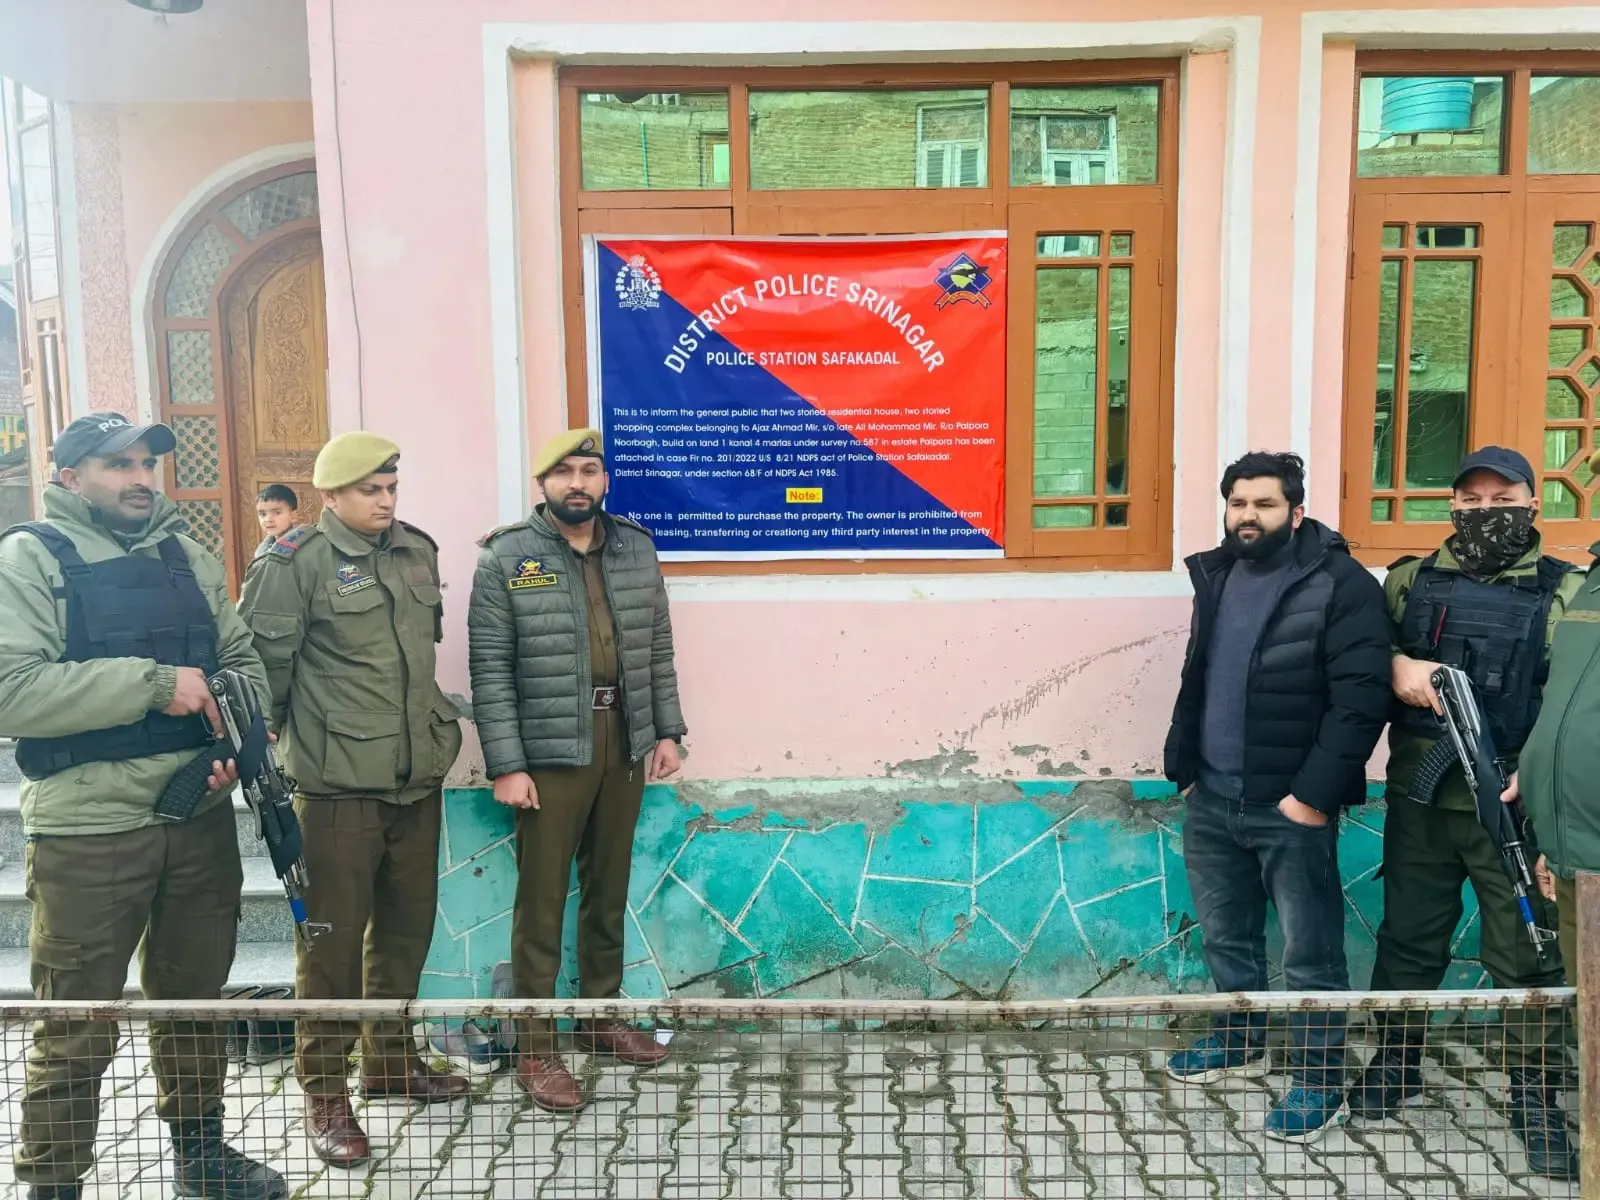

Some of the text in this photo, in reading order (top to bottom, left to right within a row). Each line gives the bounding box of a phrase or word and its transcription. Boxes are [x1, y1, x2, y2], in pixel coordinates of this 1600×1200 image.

[663, 273, 946, 376] DISTRICT POLICE SRINAGAR
[705, 352, 900, 365] POLICE STATION SAFAKADAL
[613, 408, 629, 416] This
[650, 409, 678, 417] inform
[680, 409, 694, 417] the
[697, 409, 729, 418] general
[731, 409, 758, 417] public
[761, 409, 778, 417] that
[780, 409, 795, 417] two
[797, 407, 826, 416] storied
[828, 408, 872, 416] residential
[904, 408, 920, 416] two
[613, 424, 653, 433] shopping
[656, 424, 693, 432] complex
[695, 424, 739, 433] belonging
[741, 424, 749, 432] to
[751, 424, 770, 432] Ajaz
[771, 424, 803, 432] Ahmad
[836, 423, 853, 431] late
[855, 423, 866, 431] Ali
[868, 423, 921, 431] Mohammad
[820, 440, 848, 448] survey
[891, 438, 918, 446] estate
[955, 438, 970, 446] has
[972, 437, 995, 445] been
[837, 454, 846, 462] of
[848, 454, 874, 462] Police
[875, 453, 905, 461] Station
[615, 469, 643, 477] District
[684, 470, 709, 478] under
[815, 469, 839, 477] 1985.
[790, 491, 820, 501] Note:
[628, 511, 642, 521] No
[664, 512, 673, 520] is
[678, 512, 723, 521] permitted
[737, 512, 782, 521] purchase
[783, 512, 799, 520] the
[801, 513, 844, 521] property.
[846, 511, 864, 519] The
[897, 511, 906, 519] is
[908, 510, 958, 520] prohibited
[960, 510, 983, 520] from
[655, 529, 693, 537] leasing,
[694, 529, 750, 537] transferring
[811, 530, 828, 538] any
[831, 528, 854, 536] third
[856, 528, 880, 537] party
[882, 528, 919, 536] interest
[950, 527, 992, 536] property.
[516, 578, 550, 586] RAHUL
